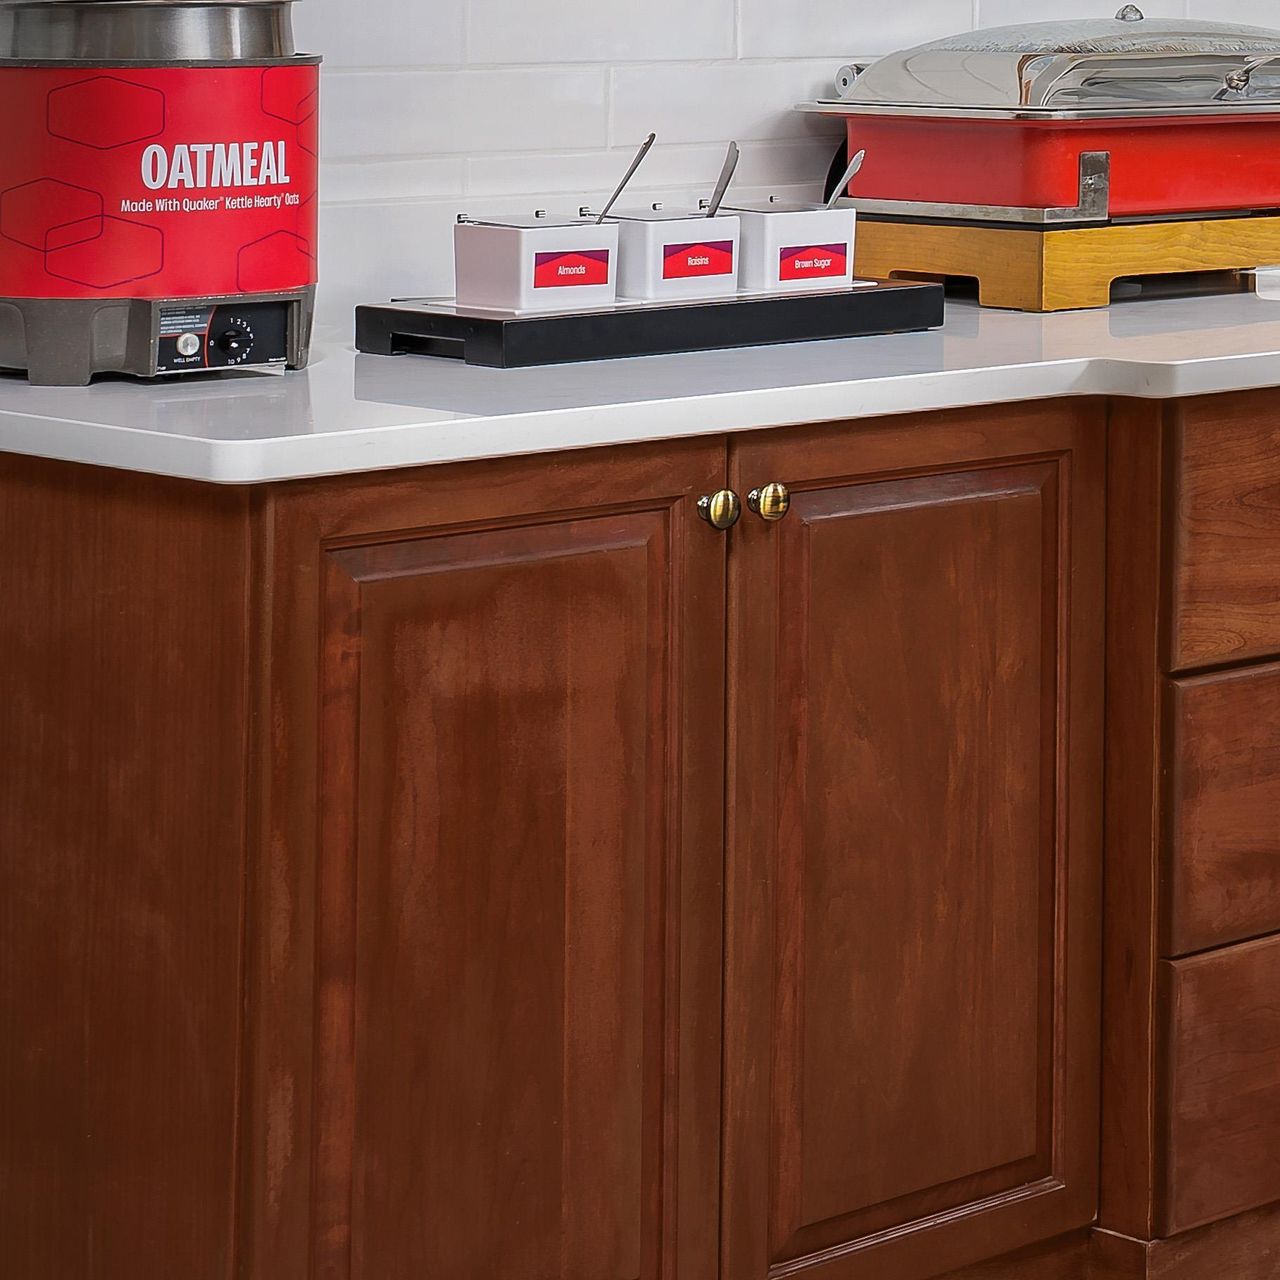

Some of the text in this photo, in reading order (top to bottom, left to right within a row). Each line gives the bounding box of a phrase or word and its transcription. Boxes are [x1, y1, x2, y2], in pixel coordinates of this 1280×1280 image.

[141, 141, 290, 190] OATMEAL
[121, 199, 153, 212] Made
[155, 198, 180, 211] With
[226, 196, 253, 210] Kettle
[285, 194, 299, 205] Oats
[558, 265, 586, 275] Almonds
[795, 258, 832, 269] Brown Sugar
